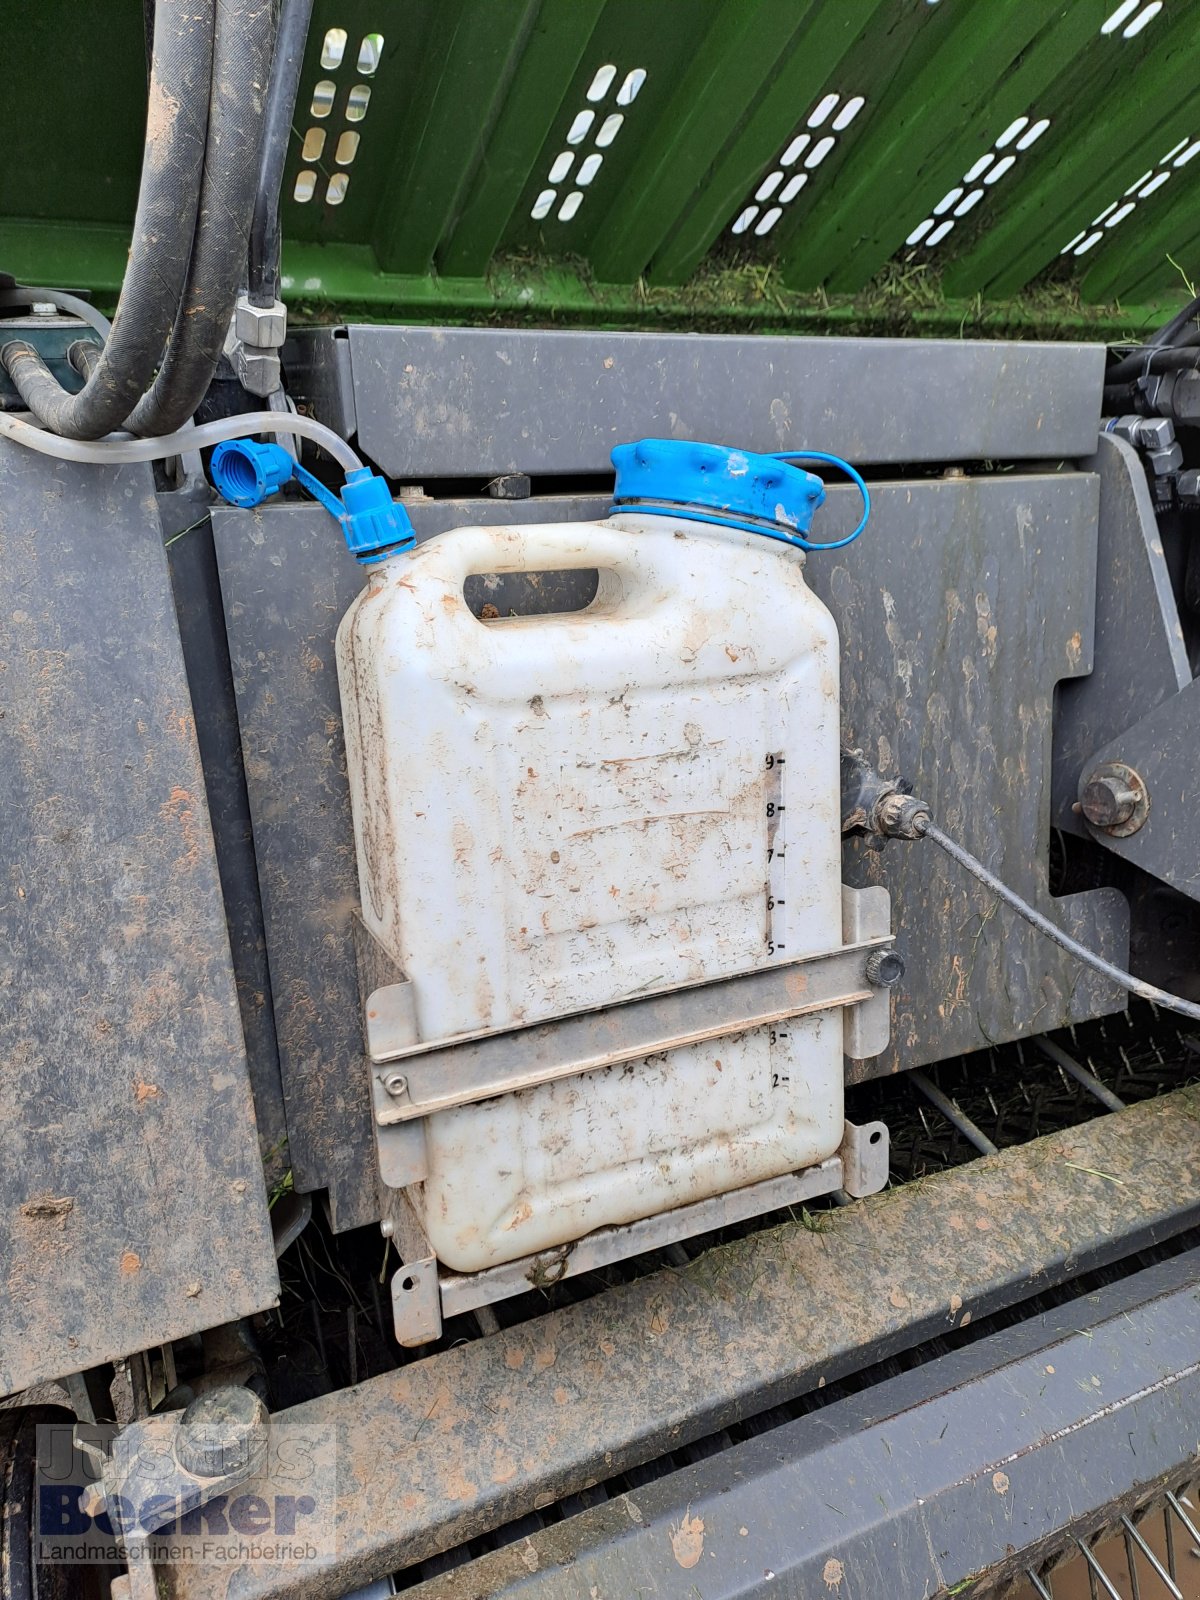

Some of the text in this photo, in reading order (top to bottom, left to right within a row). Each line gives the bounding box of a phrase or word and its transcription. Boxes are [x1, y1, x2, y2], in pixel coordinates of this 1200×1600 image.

[765, 755, 774, 770] 9
[766, 802, 775, 817] 8
[767, 848, 775, 864] 7
[767, 896, 775, 911] 6
[767, 941, 775, 956] 5
[770, 1031, 777, 1046] 3
[773, 1073, 779, 1088] 2
